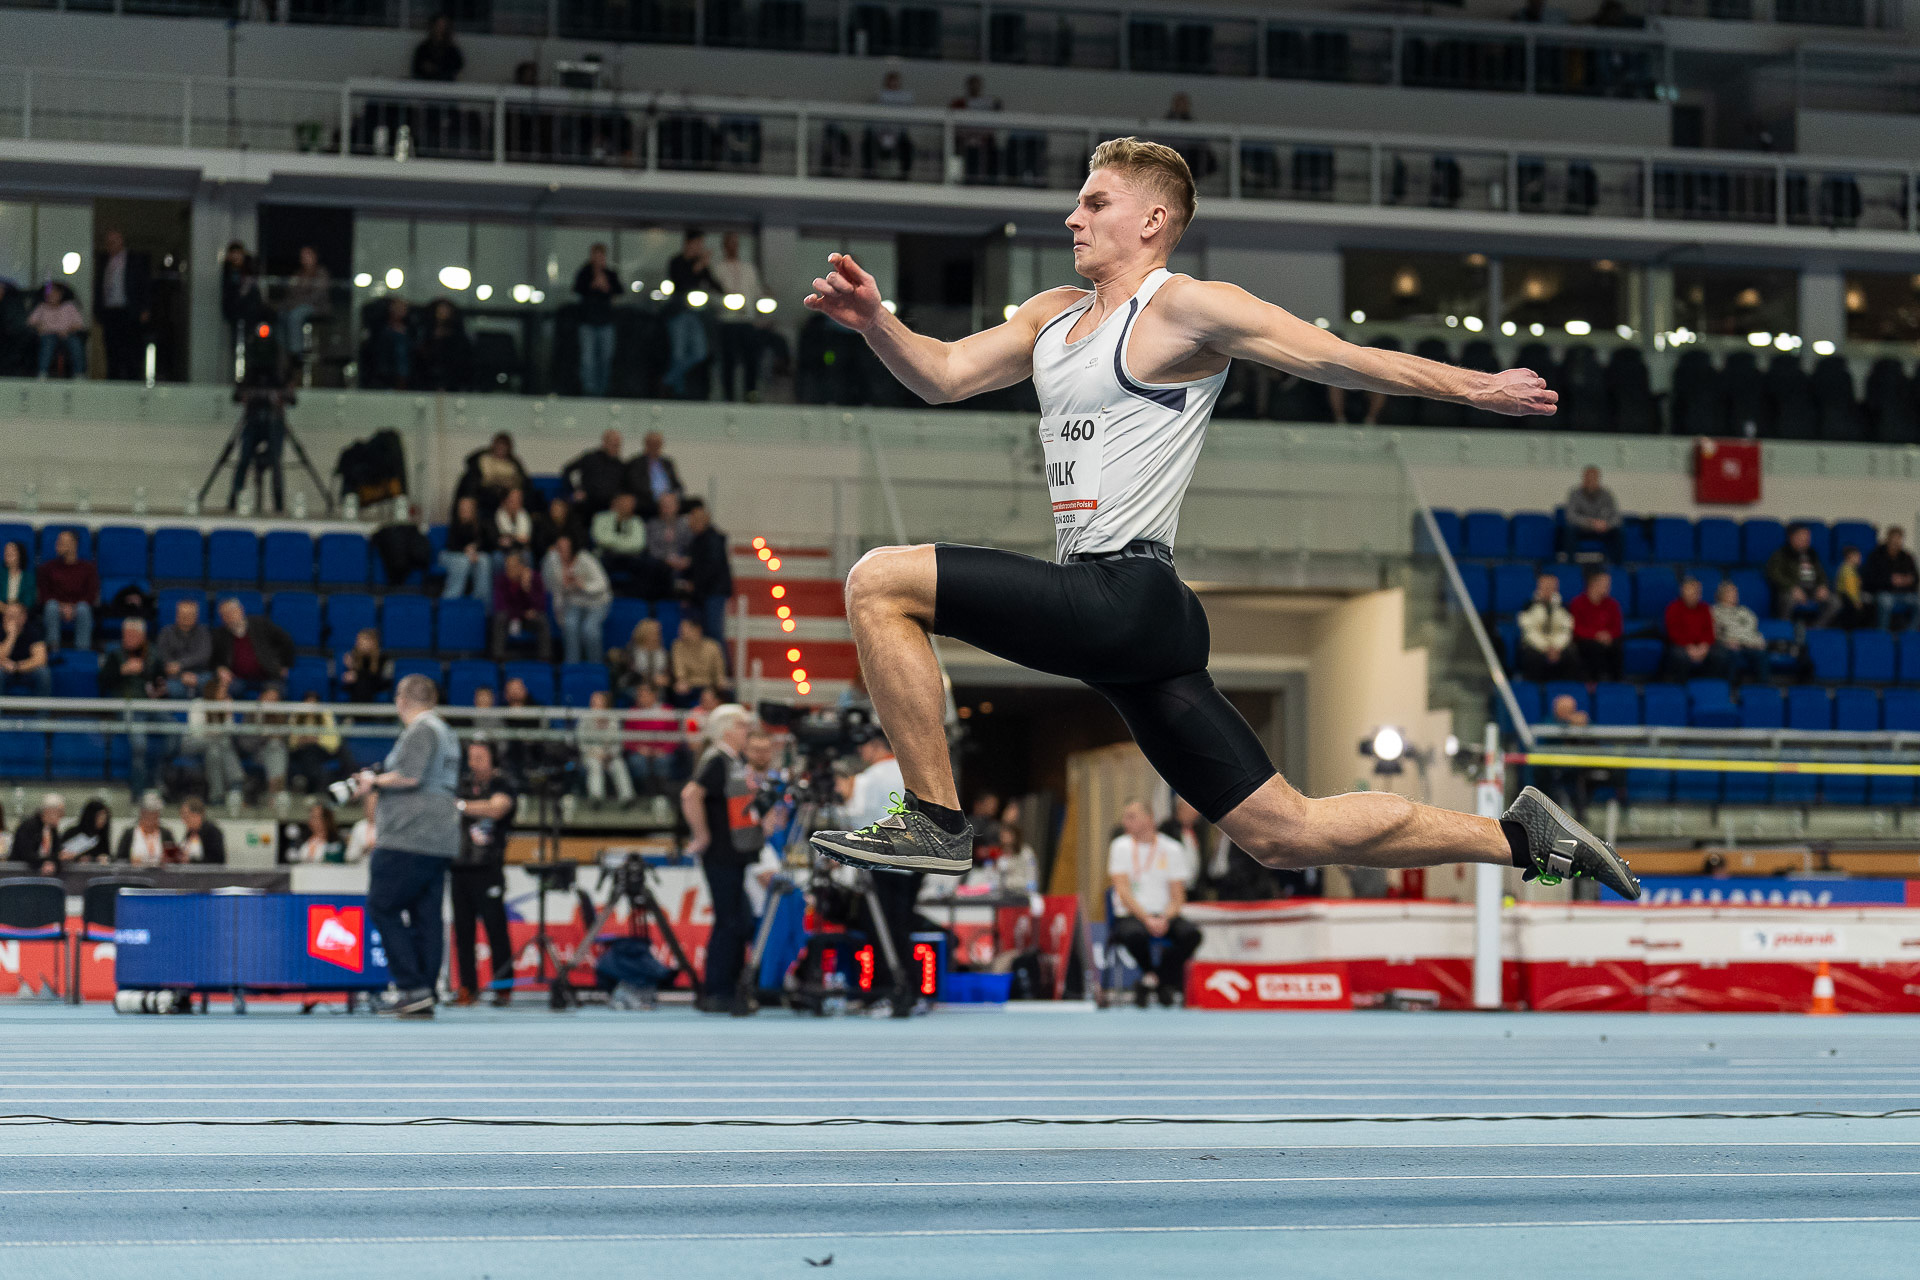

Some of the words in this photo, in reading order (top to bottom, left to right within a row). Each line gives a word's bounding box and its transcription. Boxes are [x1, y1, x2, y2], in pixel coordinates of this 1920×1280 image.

[1061, 419, 1095, 441] 460
[1046, 461, 1076, 487] WILK
[1077, 500, 1093, 508] Polski
[1063, 514, 1076, 524] 2025
